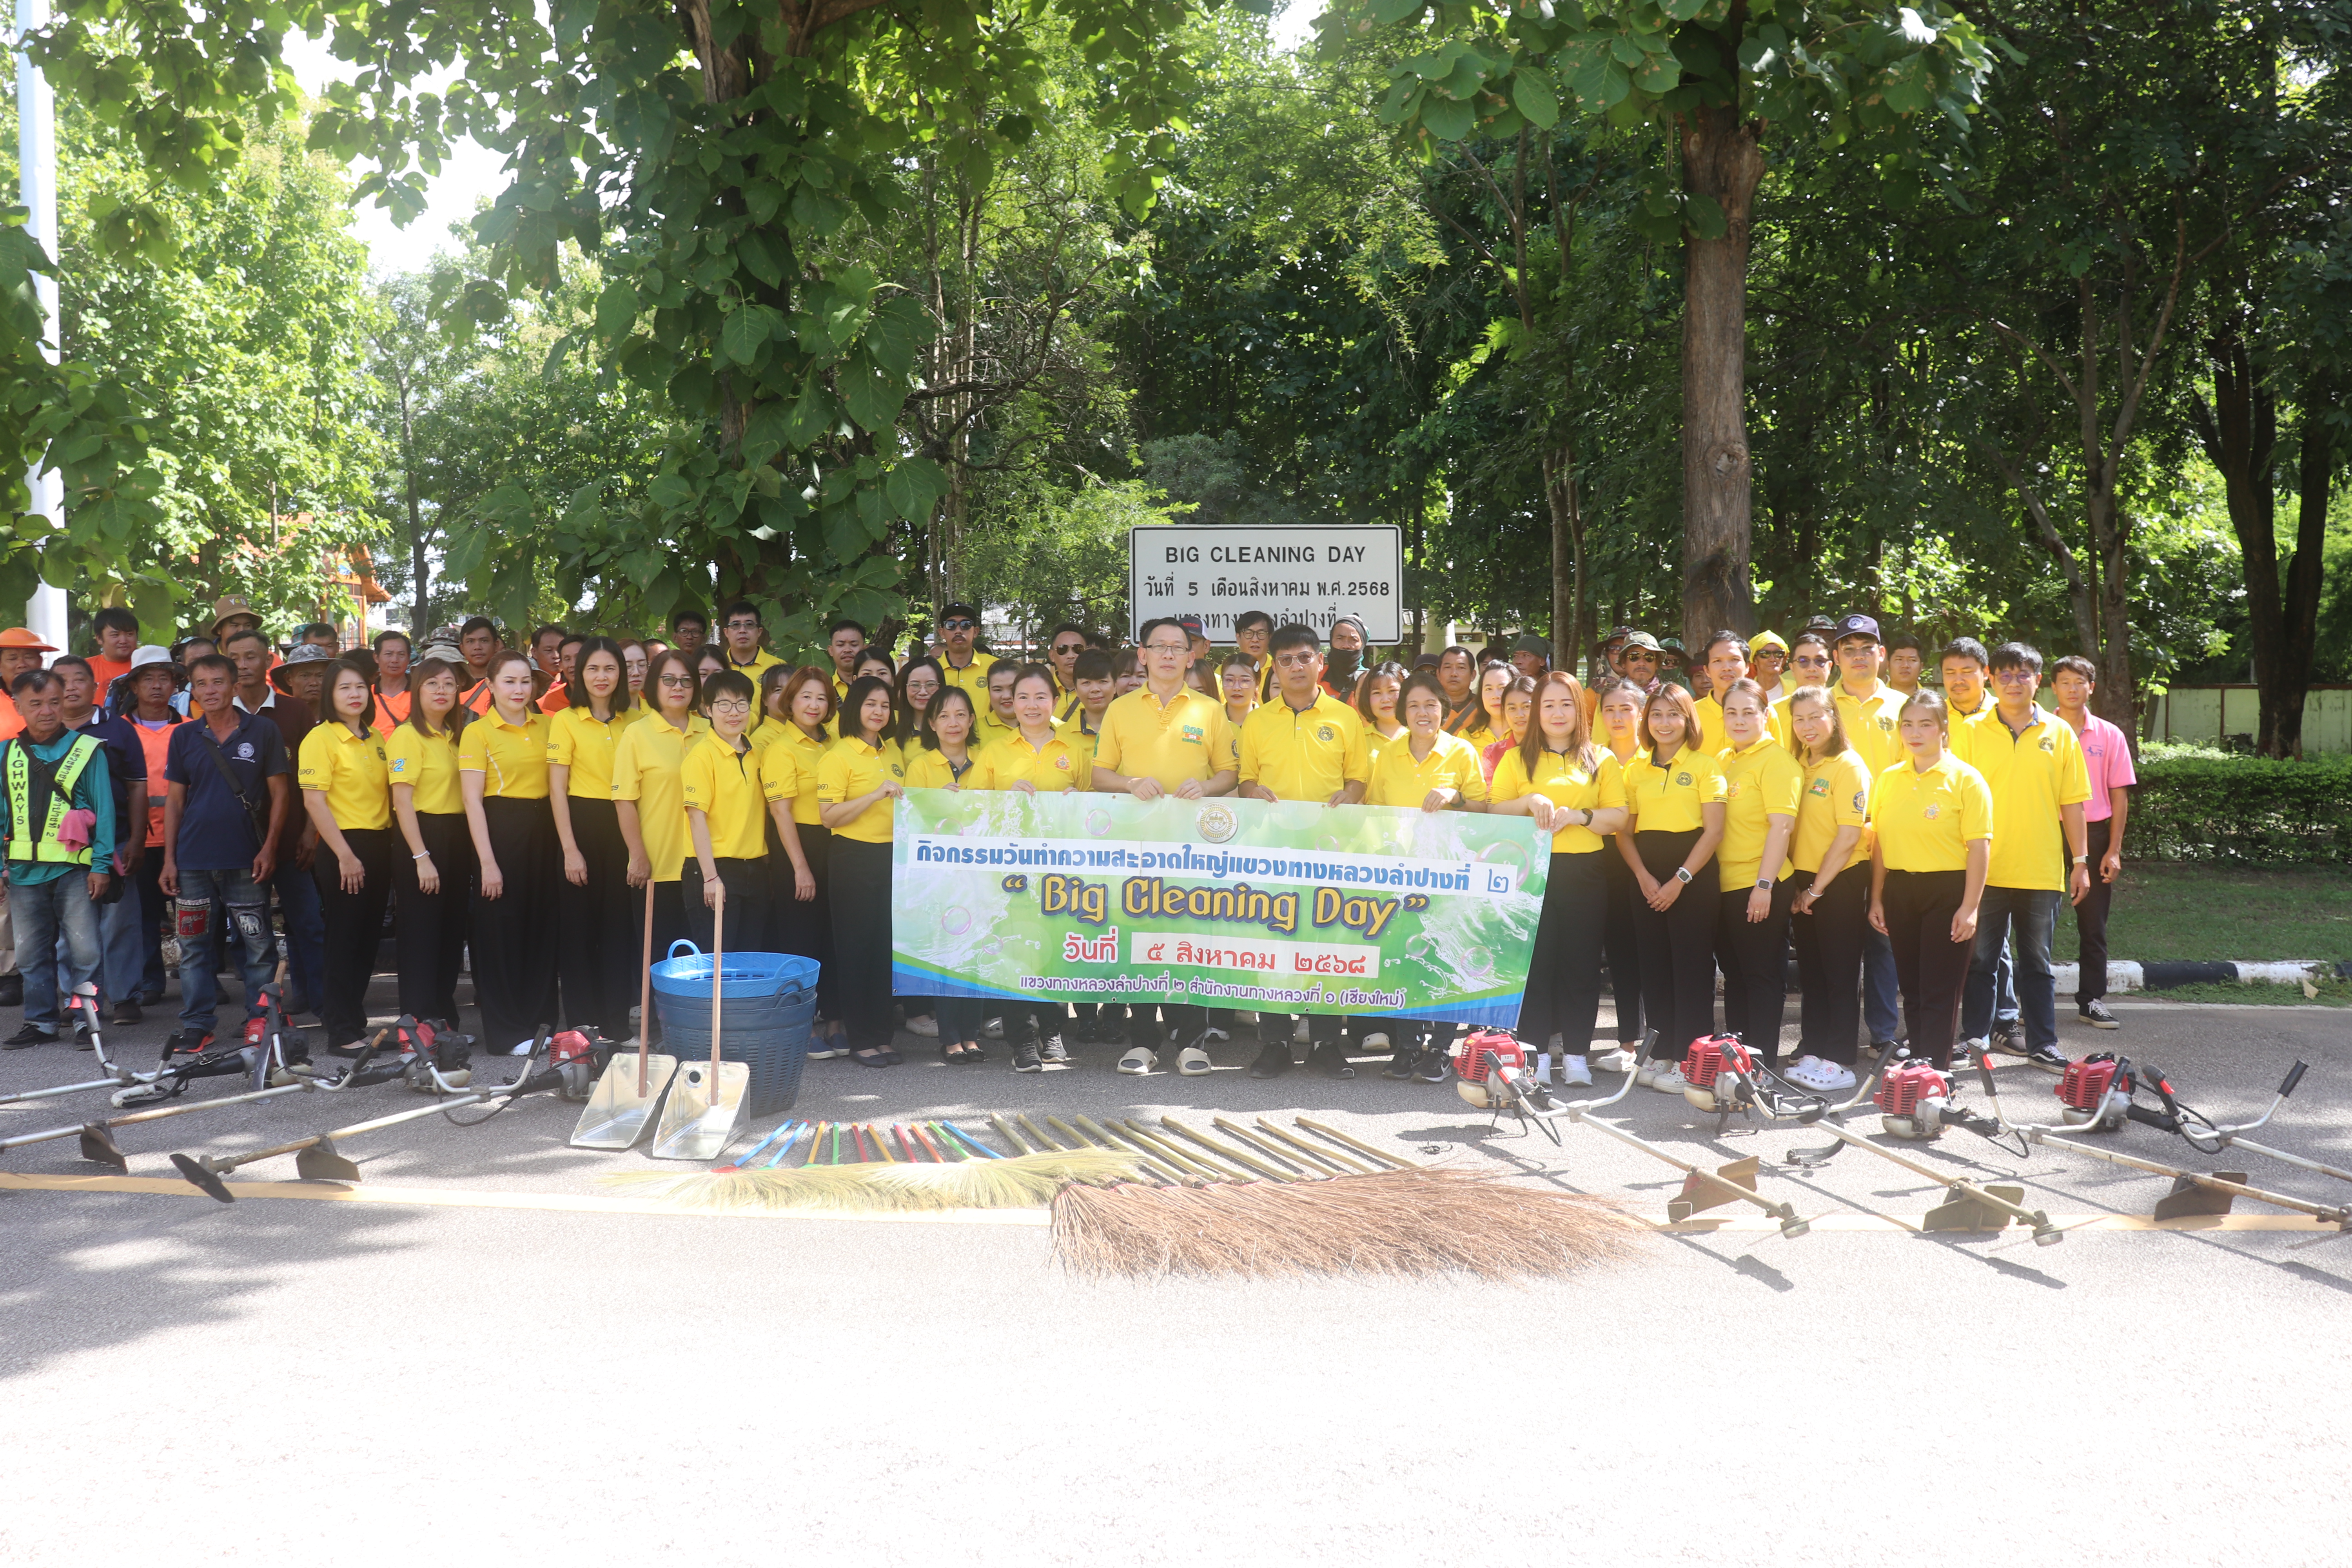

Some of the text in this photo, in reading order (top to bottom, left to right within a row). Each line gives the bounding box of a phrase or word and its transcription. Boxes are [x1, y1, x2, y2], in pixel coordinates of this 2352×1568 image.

[1166, 546, 1366, 563] BIG CLEANING DAY
[1143, 572, 1173, 596] วันที่
[1188, 582, 1198, 596] 5
[1212, 577, 1310, 596] เดือนสิงหาคม
[1487, 869, 1509, 893] ๒
[1044, 875, 1106, 924] Big
[1124, 878, 1298, 932] Cleaning
[1315, 887, 1396, 937] Day
[1065, 928, 1367, 975] วันที่ ๕ สิงหาคม ๒๕๖๘
[1021, 971, 1406, 1008] แขวงทางหลวงลำปางที่ ๒ สำนักงานทางหลวงที่ ๑ (เชียงใหม่)
